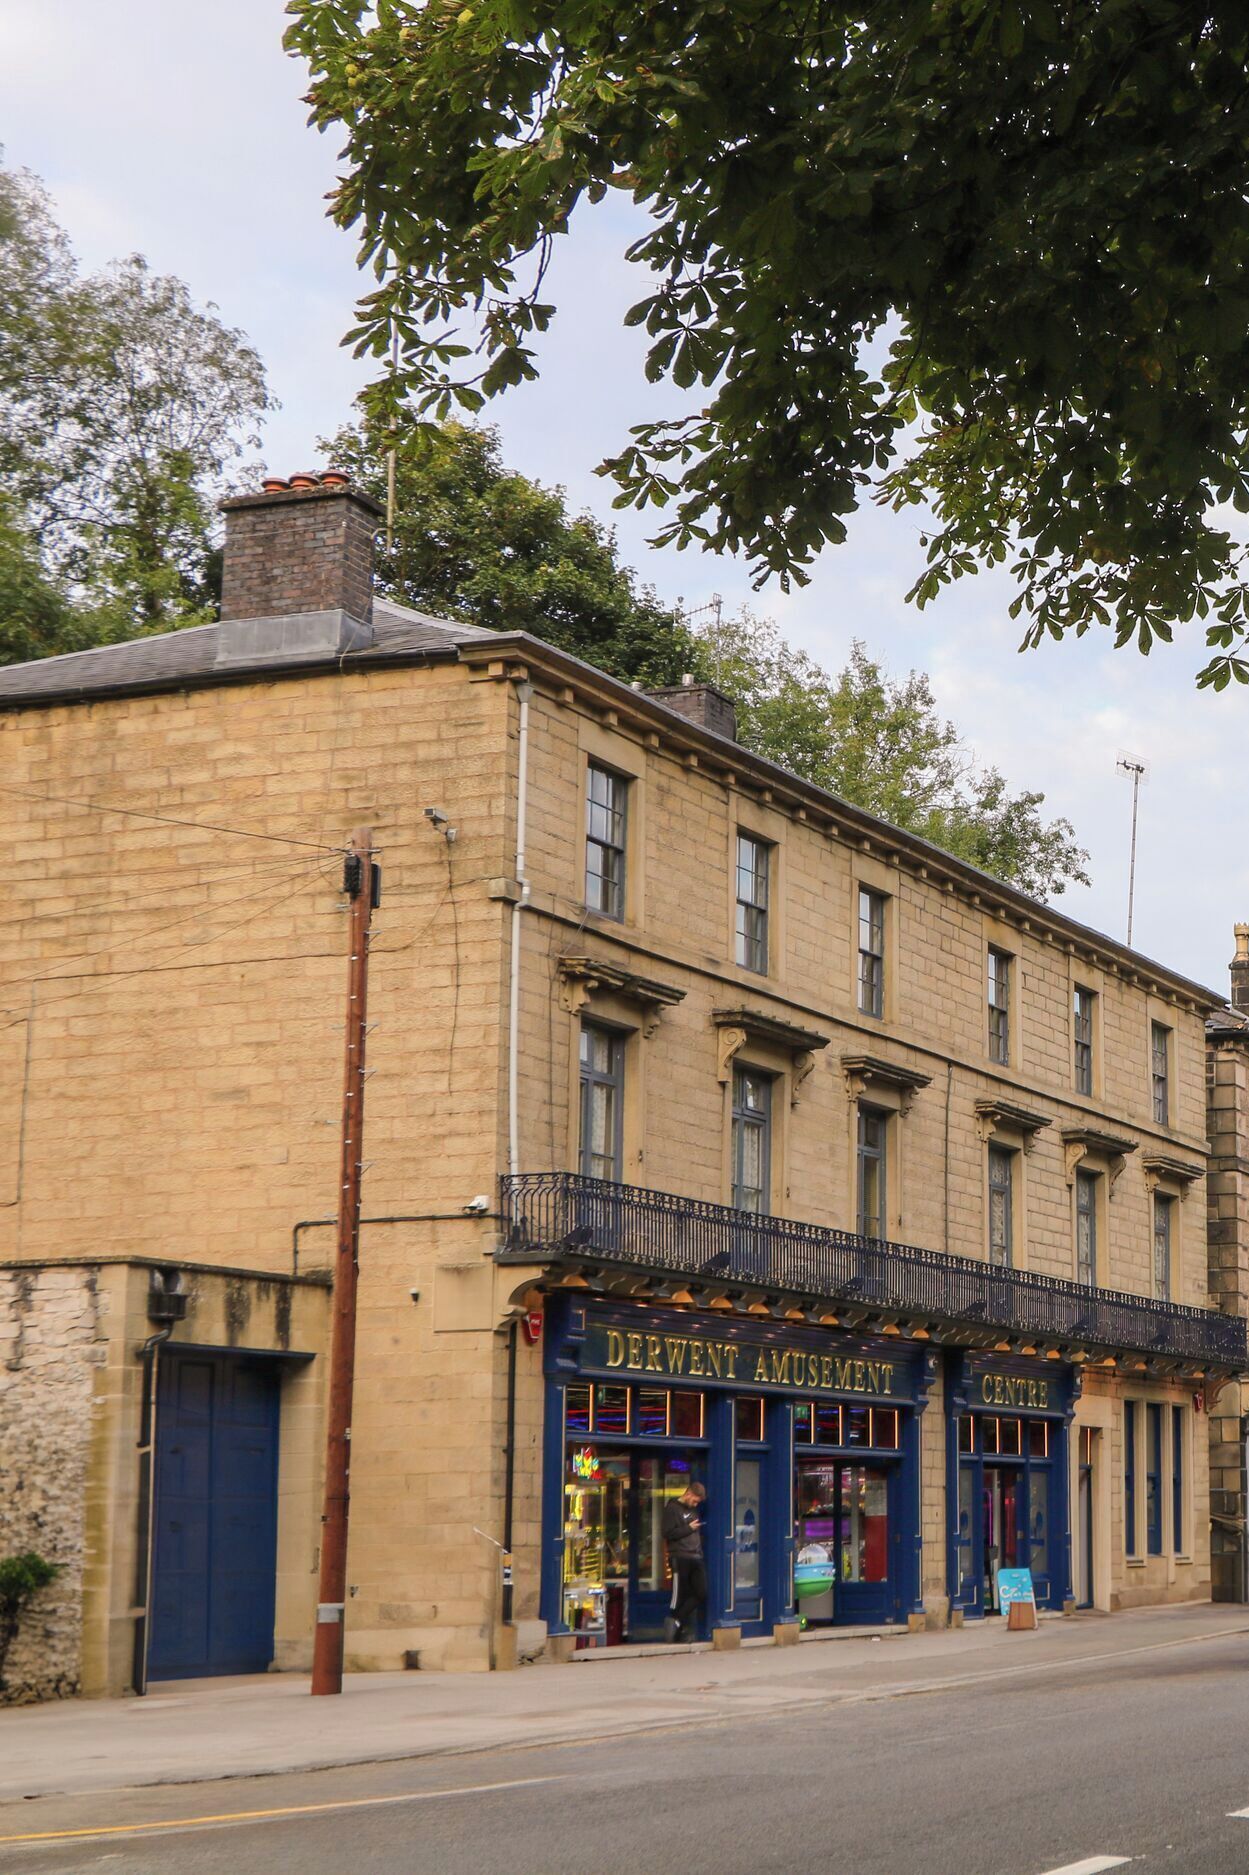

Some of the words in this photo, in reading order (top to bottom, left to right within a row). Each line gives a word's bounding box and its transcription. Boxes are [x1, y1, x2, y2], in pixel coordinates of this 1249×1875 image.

[606, 1329, 739, 1379] DERWENT
[753, 1347, 895, 1395] AMUSEMENT
[981, 1373, 1049, 1408] CENTRE
